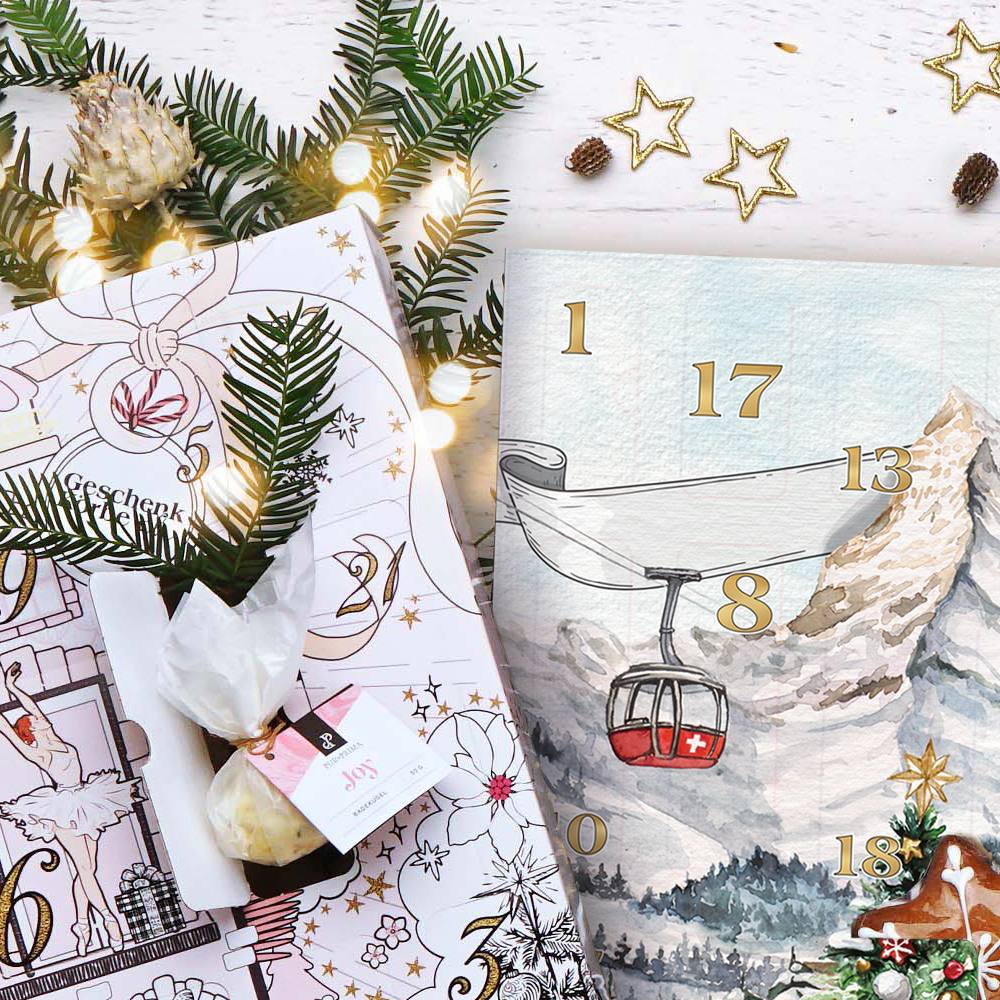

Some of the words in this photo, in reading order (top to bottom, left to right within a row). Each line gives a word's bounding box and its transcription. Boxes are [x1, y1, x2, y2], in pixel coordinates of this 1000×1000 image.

[561, 301, 592, 355] 1
[689, 361, 784, 419] 17
[176, 420, 214, 483] 5
[840, 446, 913, 494] 13
[64, 472, 186, 523] Geschenk
[336, 541, 406, 618] 21
[716, 572, 774, 634] 8
[553, 812, 608, 856] 0
[834, 834, 902, 879] 18
